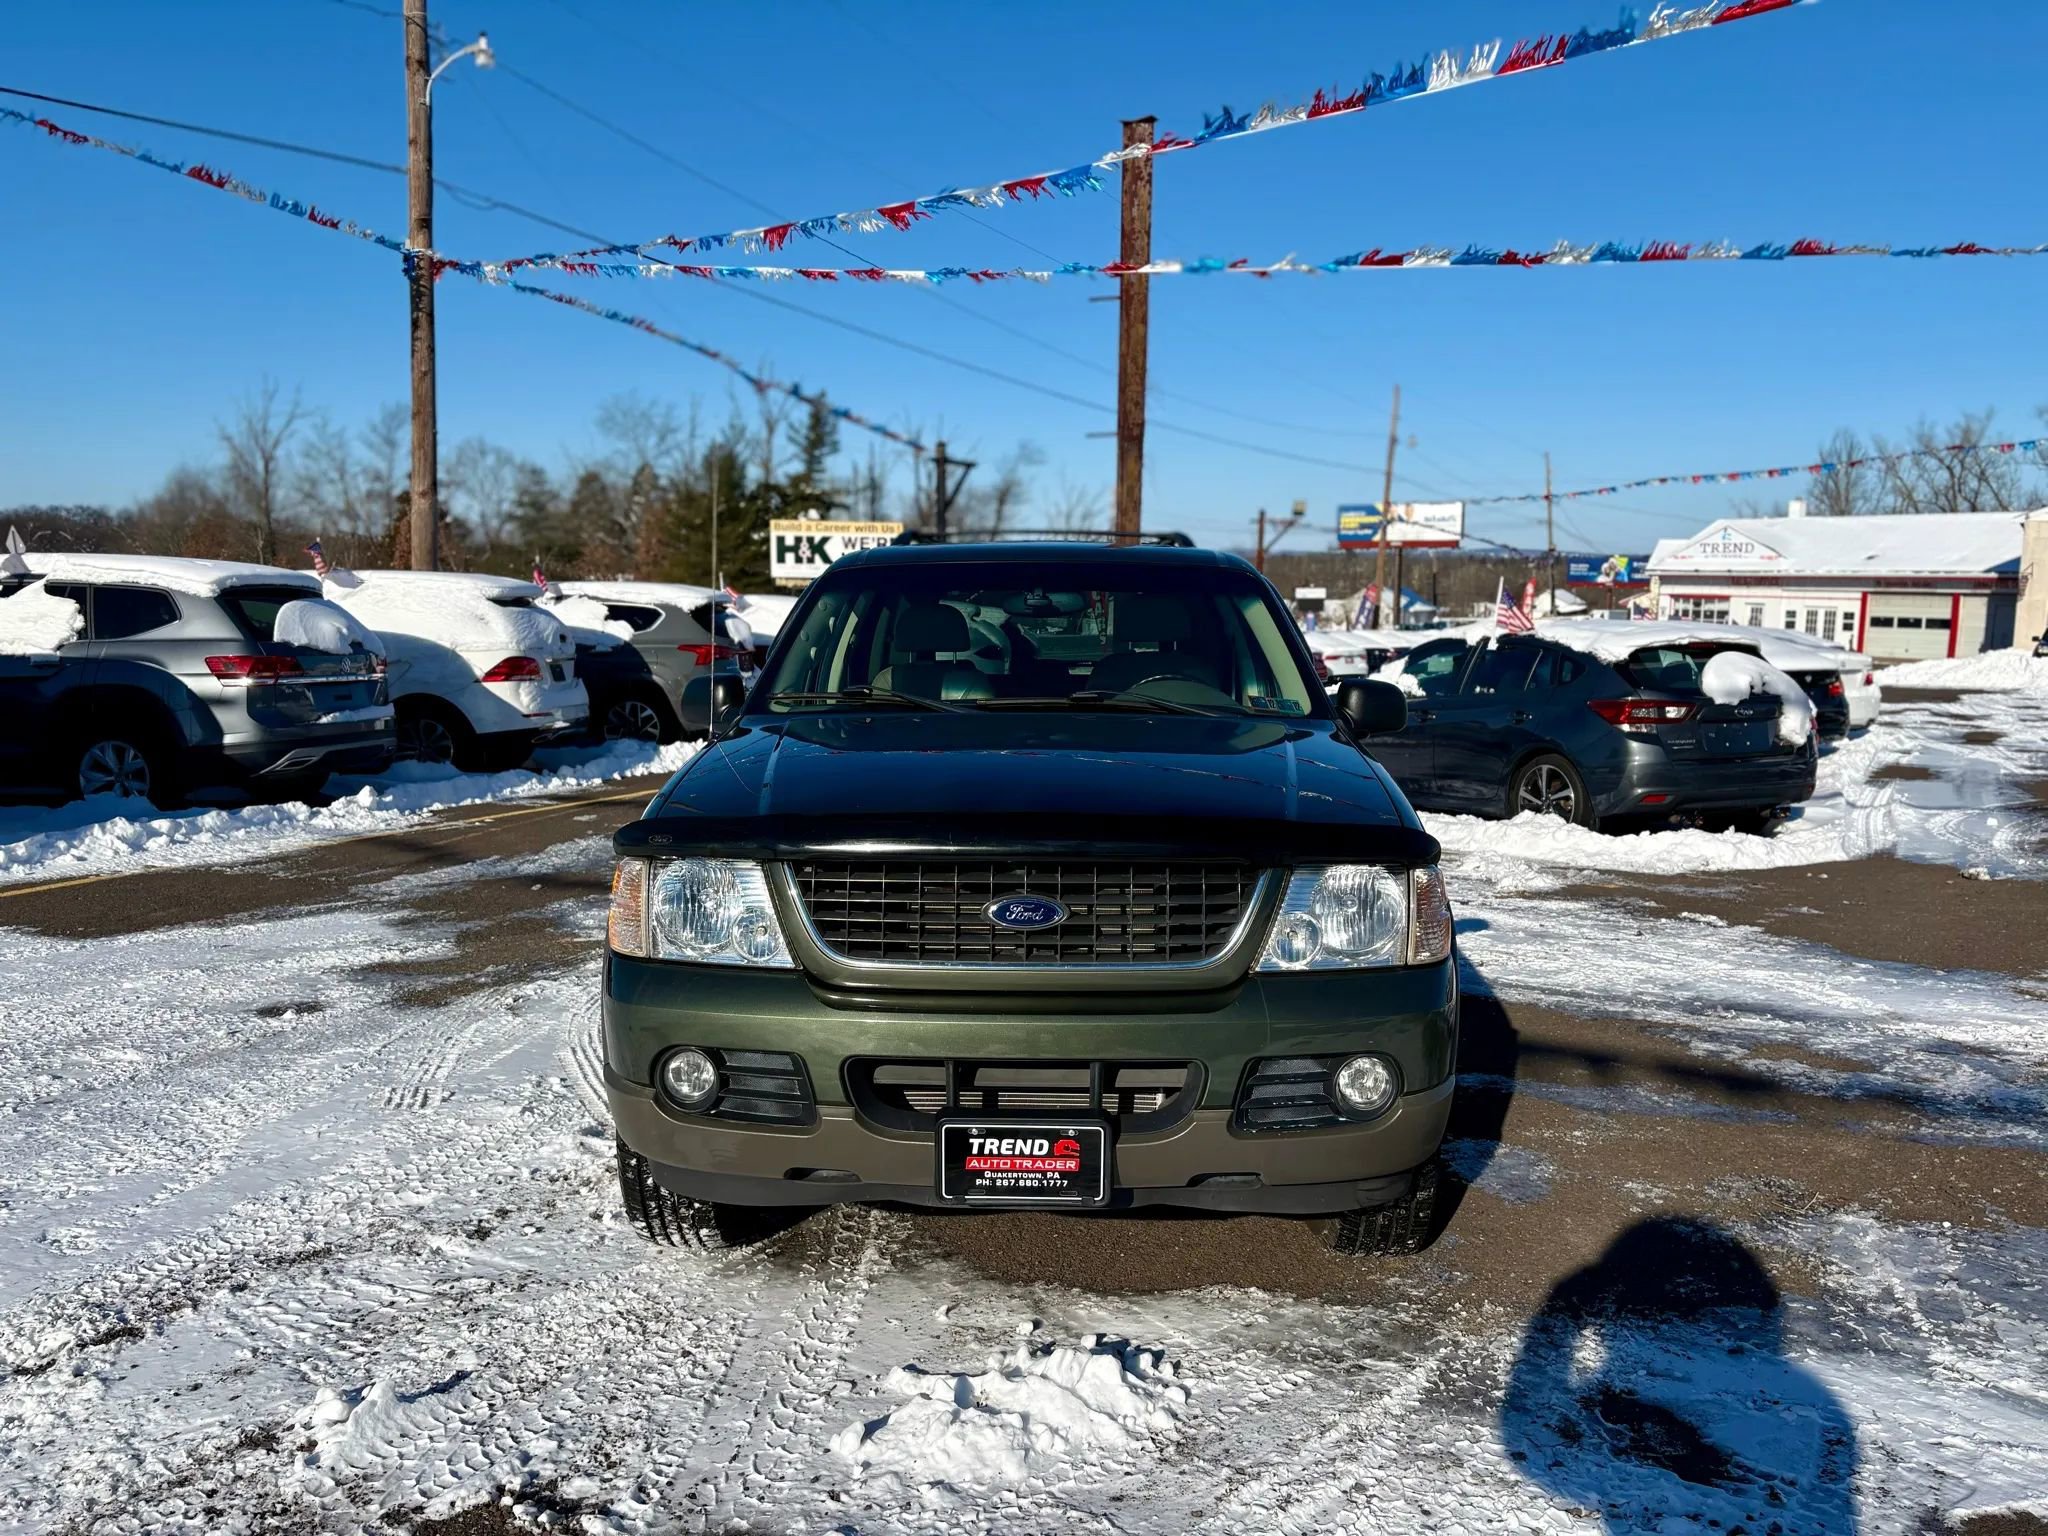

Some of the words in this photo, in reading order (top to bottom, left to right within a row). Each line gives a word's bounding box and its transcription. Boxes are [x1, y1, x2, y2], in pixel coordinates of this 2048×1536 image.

[774, 522, 803, 531] Build
[815, 523, 851, 532] Career
[854, 524, 879, 533] with
[776, 535, 834, 564] H&K
[841, 536, 895, 551] WE'R
[1700, 542, 1755, 554] TREND
[1006, 903, 1044, 920] Ford
[969, 1138, 1050, 1156] TREND
[968, 1159, 1011, 1168] AUTO
[1013, 1160, 1077, 1169] TRADER
